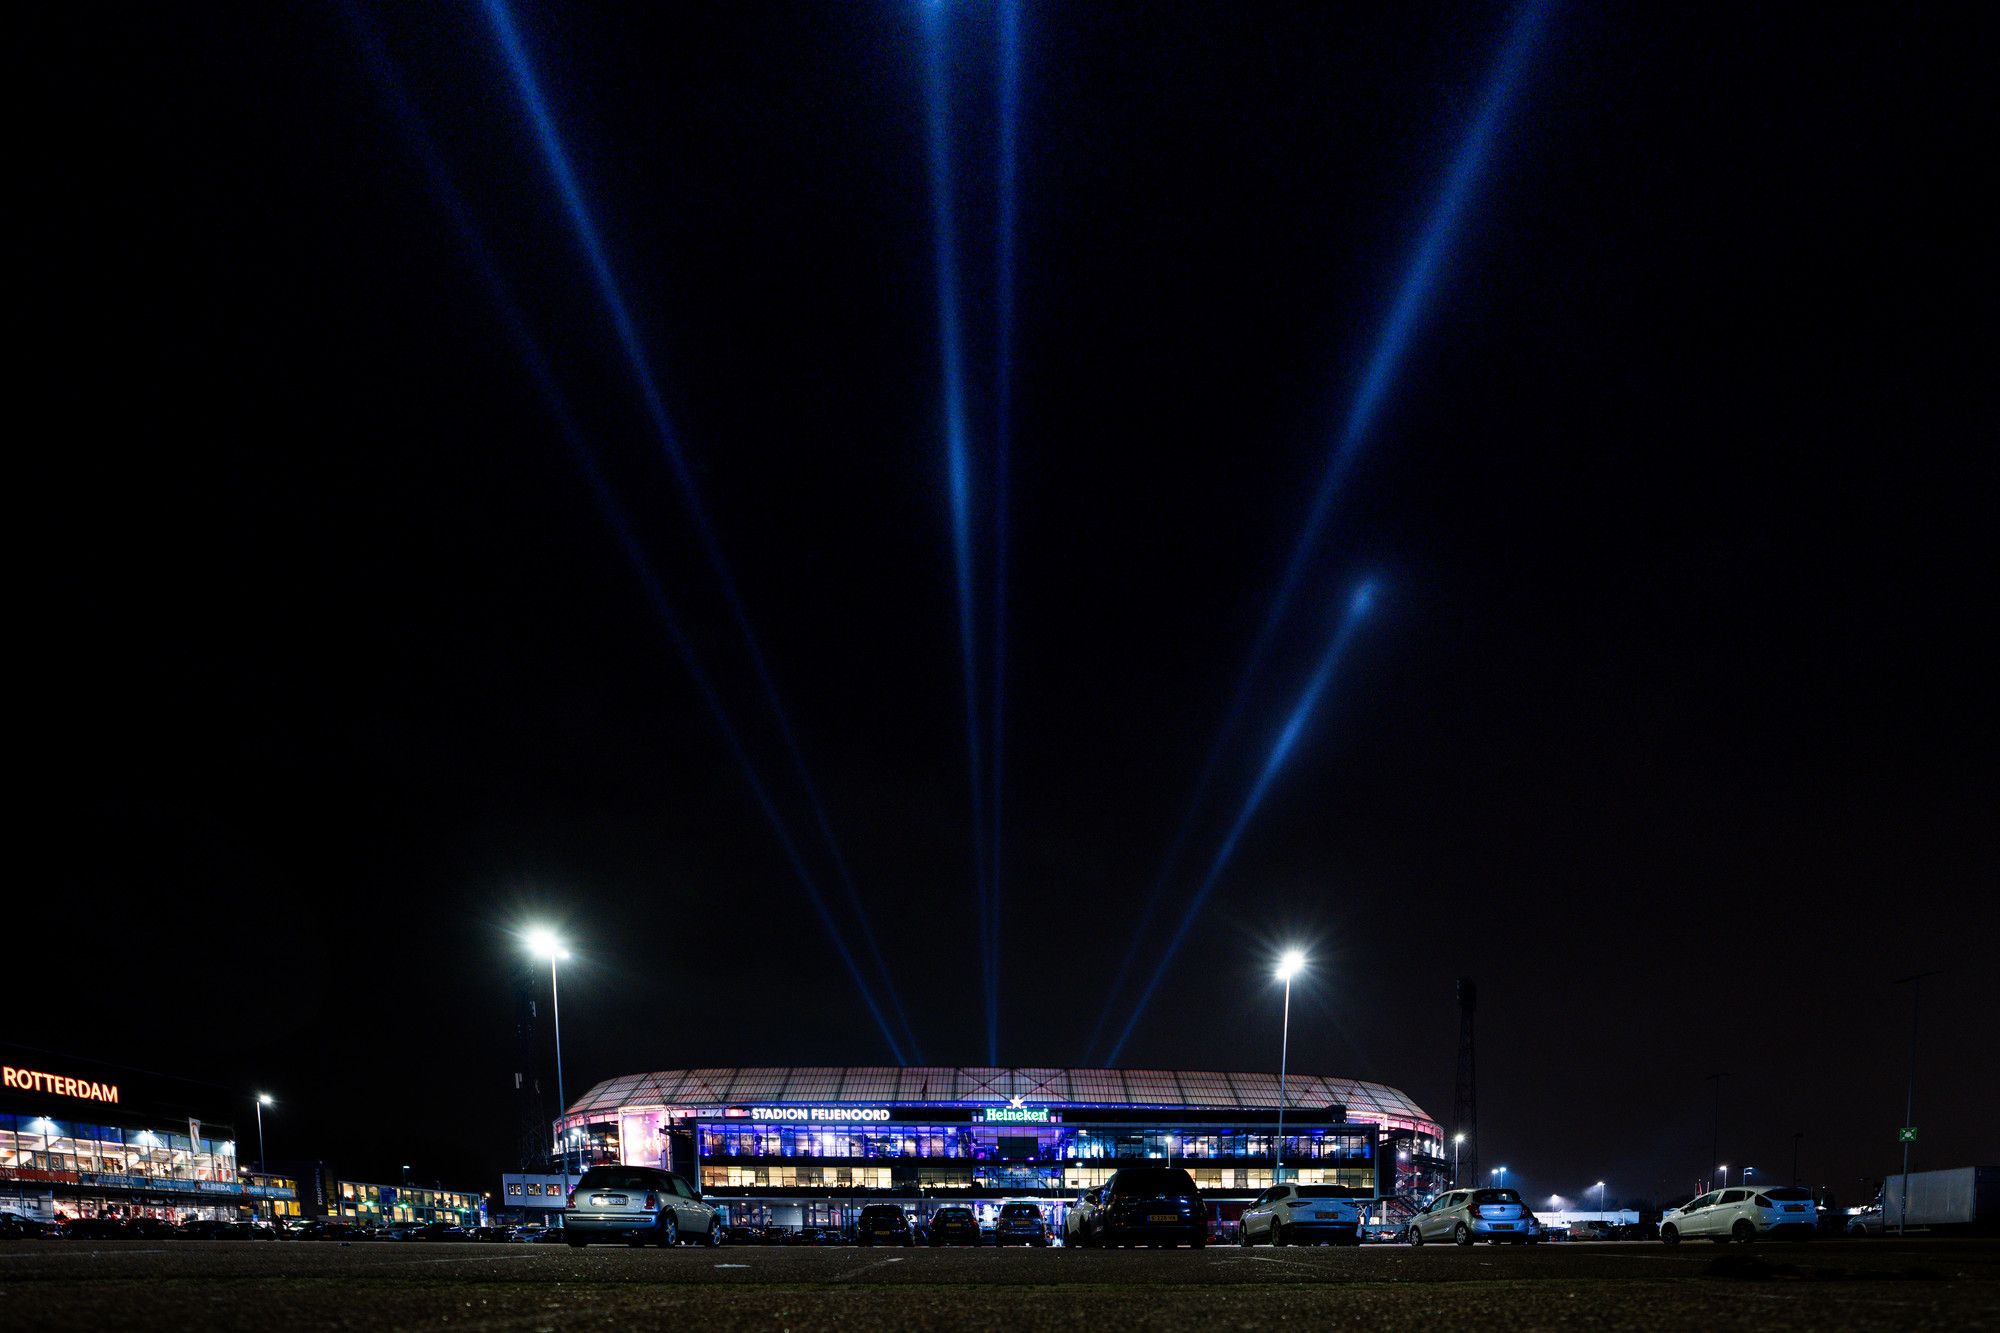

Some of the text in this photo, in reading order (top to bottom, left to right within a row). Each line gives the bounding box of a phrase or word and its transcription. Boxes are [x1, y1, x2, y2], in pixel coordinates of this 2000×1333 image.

[3, 1066, 119, 1104] ROTTERDAM
[751, 1107, 890, 1121] STADION FEIJENOORD
[986, 1107, 1048, 1121] Heineken
[201, 1182, 231, 1192] ALBEDA
